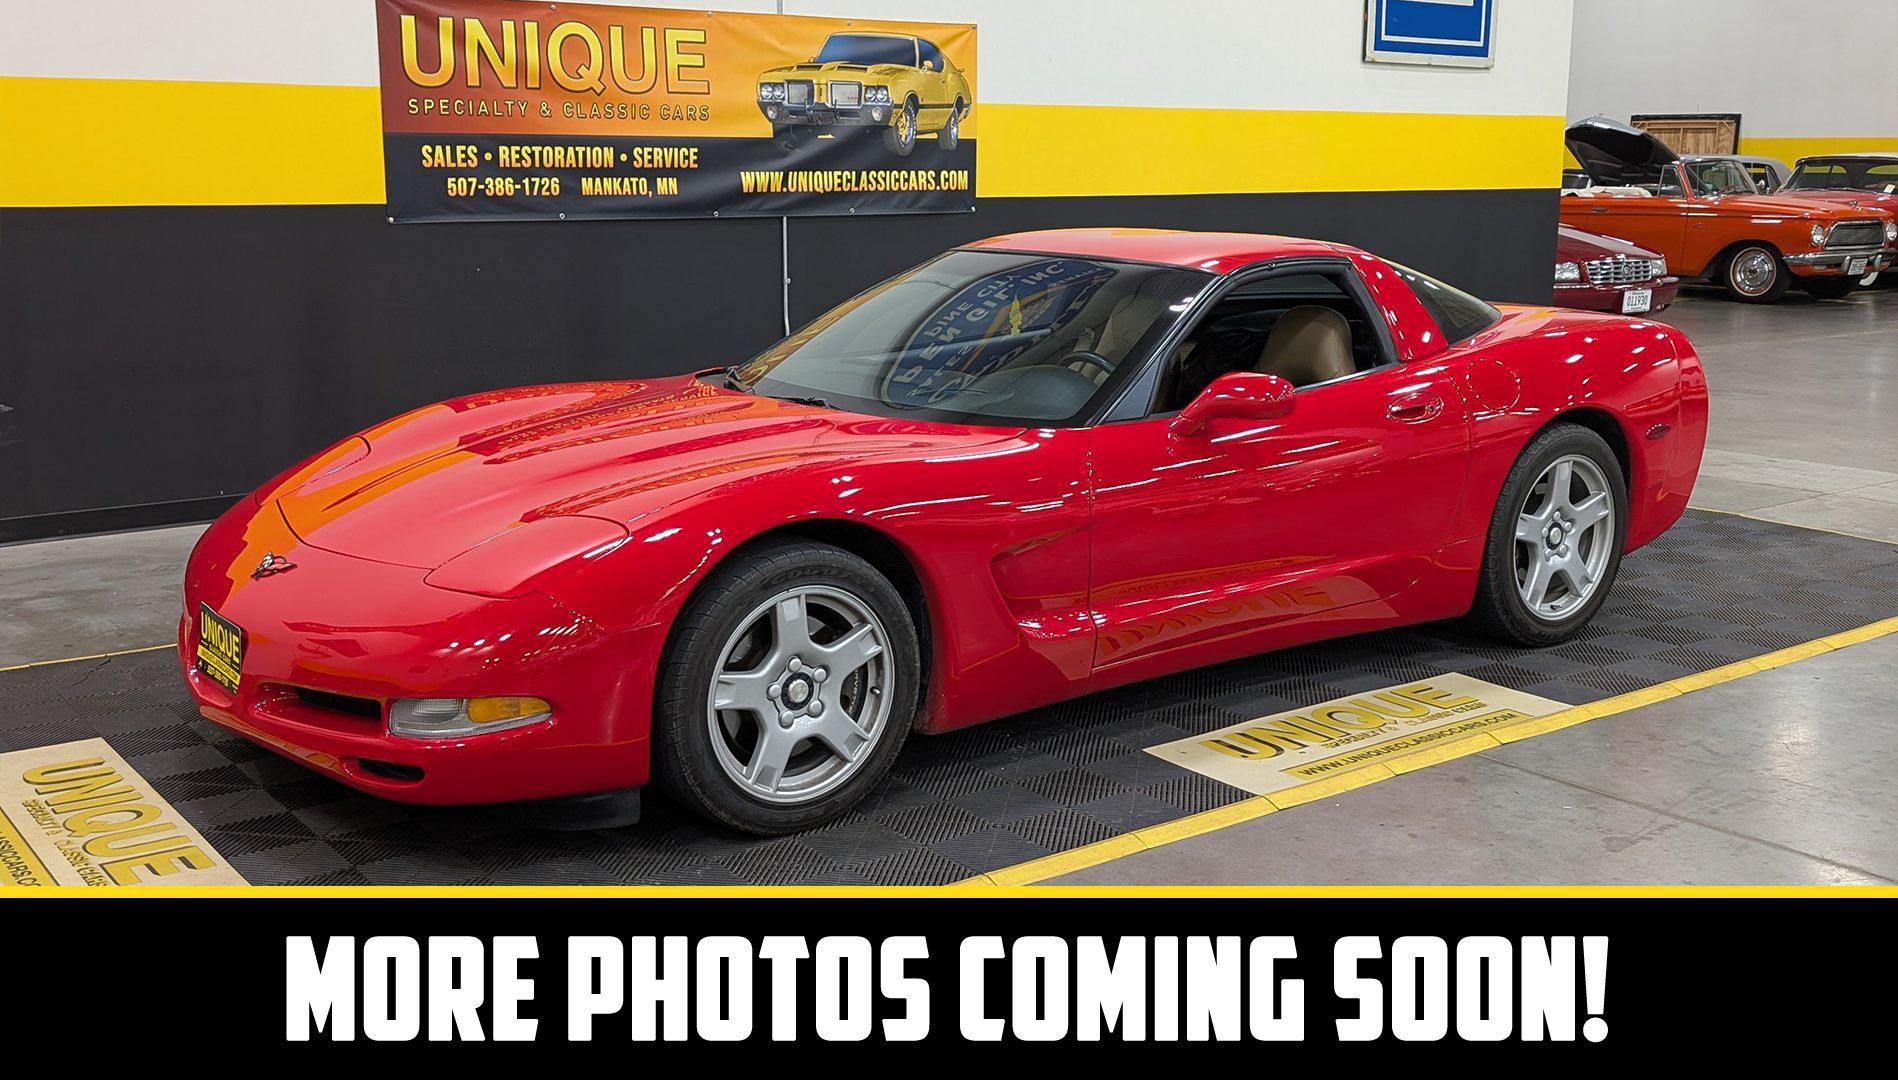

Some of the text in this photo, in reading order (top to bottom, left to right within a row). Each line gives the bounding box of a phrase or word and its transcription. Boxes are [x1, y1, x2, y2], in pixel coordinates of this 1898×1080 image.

[400, 13, 710, 97] UNIQUE
[408, 98, 710, 121] SPECIALTY & CLASSIC CARS
[421, 145, 699, 169] SALES RESTORATION SERVICE
[739, 169, 969, 195] WWW.UNIQUECLASSICCARS.COM
[447, 177, 679, 198] 507-386-1726 MANKATO, MN
[200, 610, 240, 665] UNIQUE
[1198, 683, 1481, 761] UNIQUE
[1299, 712, 1519, 776] WWW.UNIQUECLASSICCARS.COM
[22, 756, 217, 886] UNIQUE
